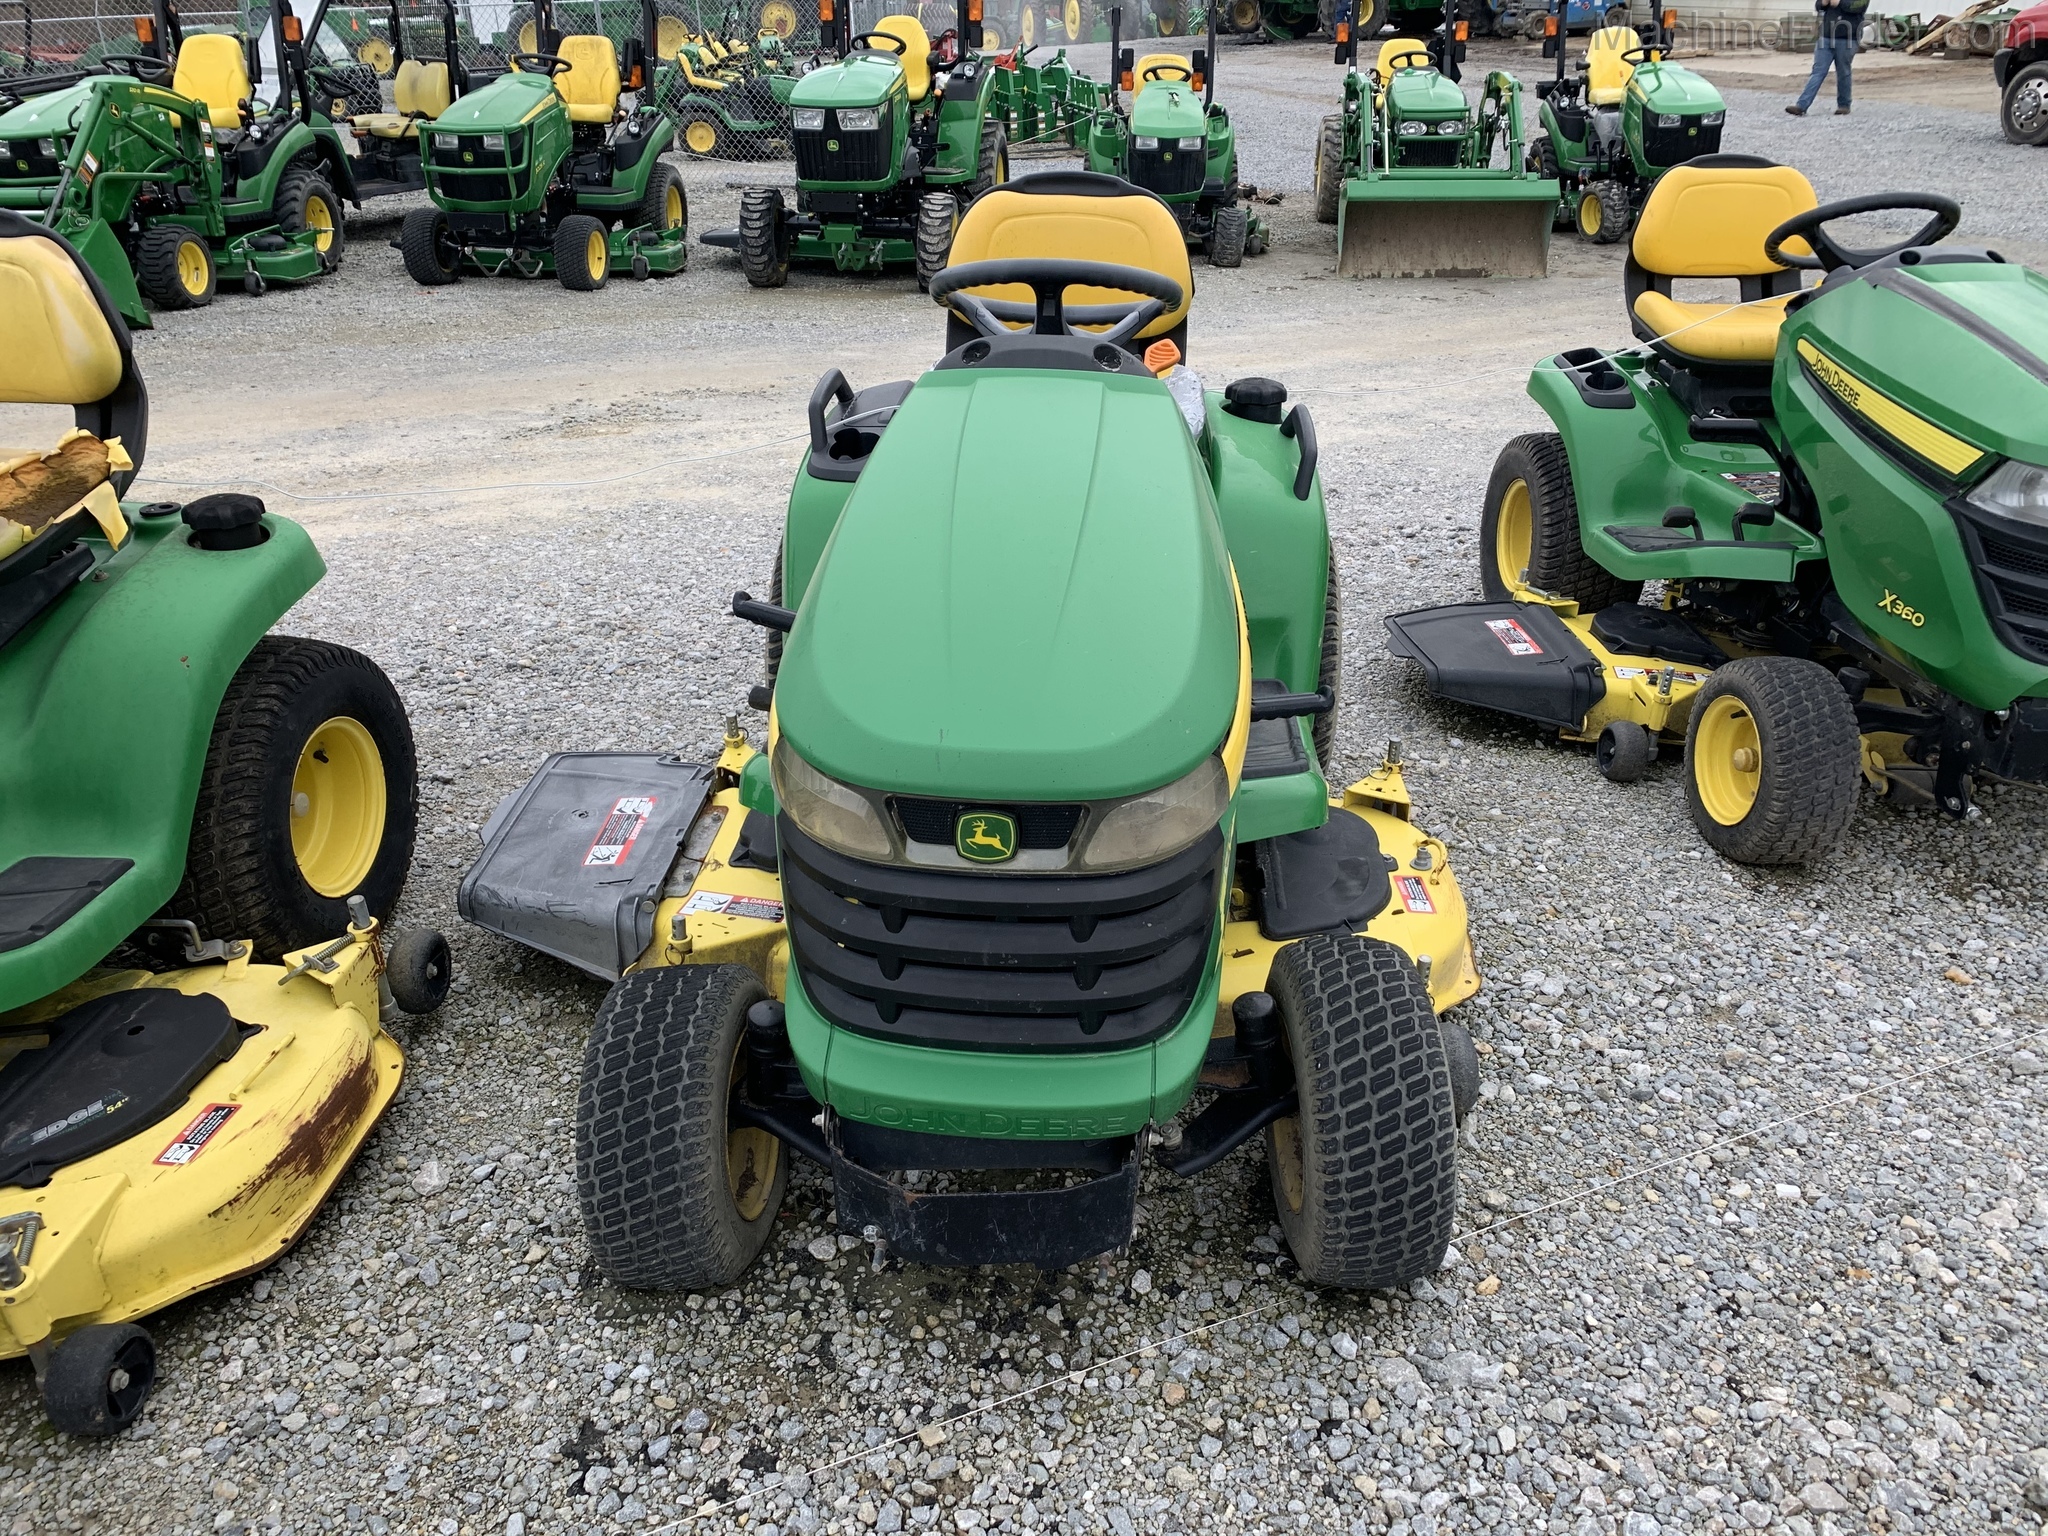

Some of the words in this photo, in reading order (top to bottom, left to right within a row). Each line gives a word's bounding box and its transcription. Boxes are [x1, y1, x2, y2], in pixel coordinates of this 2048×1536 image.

[1811, 353, 1833, 383] JOHN
[1832, 370, 1861, 406] DEERE
[1877, 588, 1925, 627] X360
[848, 1095, 968, 1133] JOHN
[978, 1109, 1128, 1137] DEERE
